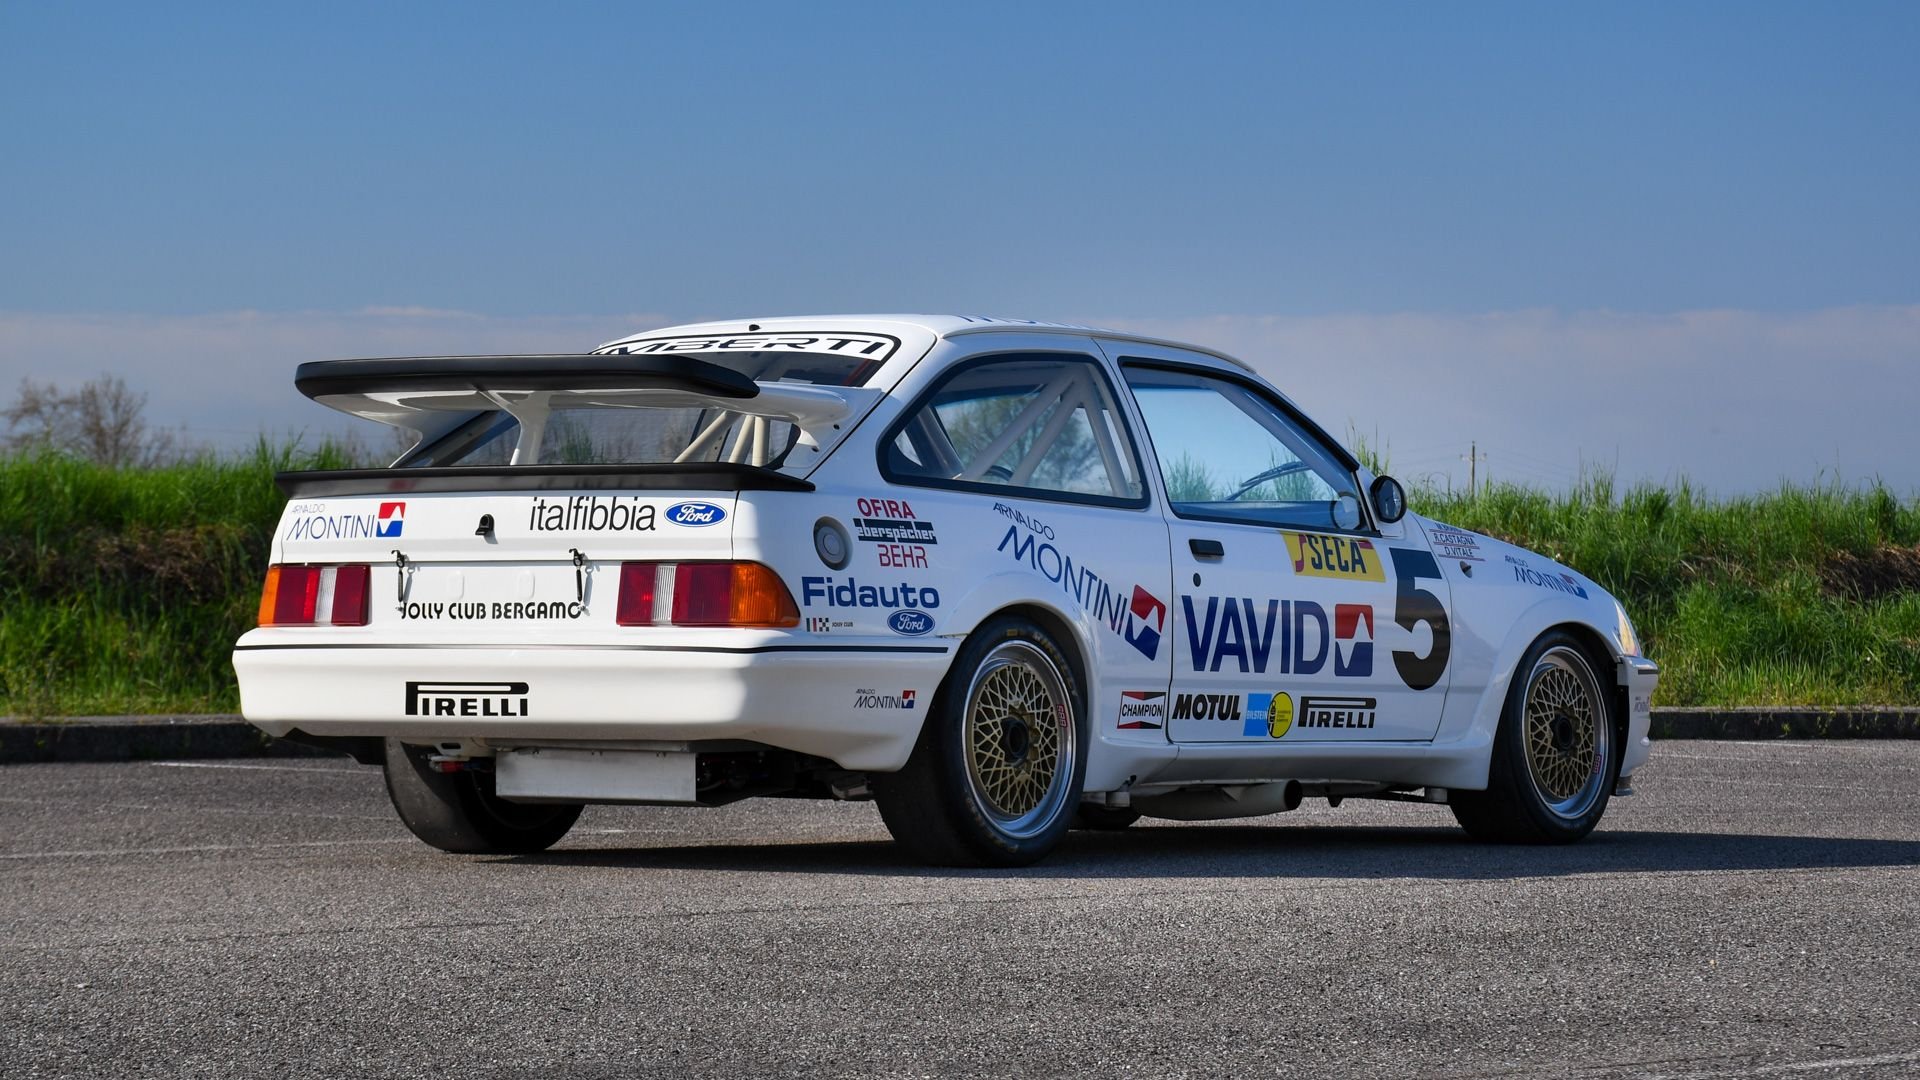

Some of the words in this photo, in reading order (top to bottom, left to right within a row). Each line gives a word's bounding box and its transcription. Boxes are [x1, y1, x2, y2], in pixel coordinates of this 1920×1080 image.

[529, 496, 656, 531] italfibbia
[676, 504, 715, 523] Ford
[857, 498, 916, 519] OFIRA
[993, 502, 1055, 541] ARNALDO
[286, 514, 375, 541] MONTINI
[857, 519, 936, 543] eberspächer
[877, 544, 928, 568] BEHR
[801, 576, 940, 609] Fidauto
[997, 525, 1128, 636] MONTINI
[1514, 565, 1573, 595] MONTINI
[401, 602, 444, 620] JOLLY
[448, 602, 487, 620] CLUB
[492, 602, 582, 620] BERGAMO
[1389, 547, 1451, 691] 5
[1181, 595, 1330, 675] VAVID
[405, 681, 529, 717] PIRELLI
[854, 695, 901, 709] MONTINI
[1121, 703, 1163, 717] CHAMPION
[1171, 694, 1241, 721] MOTUL
[1297, 695, 1377, 729] PIRELLI
